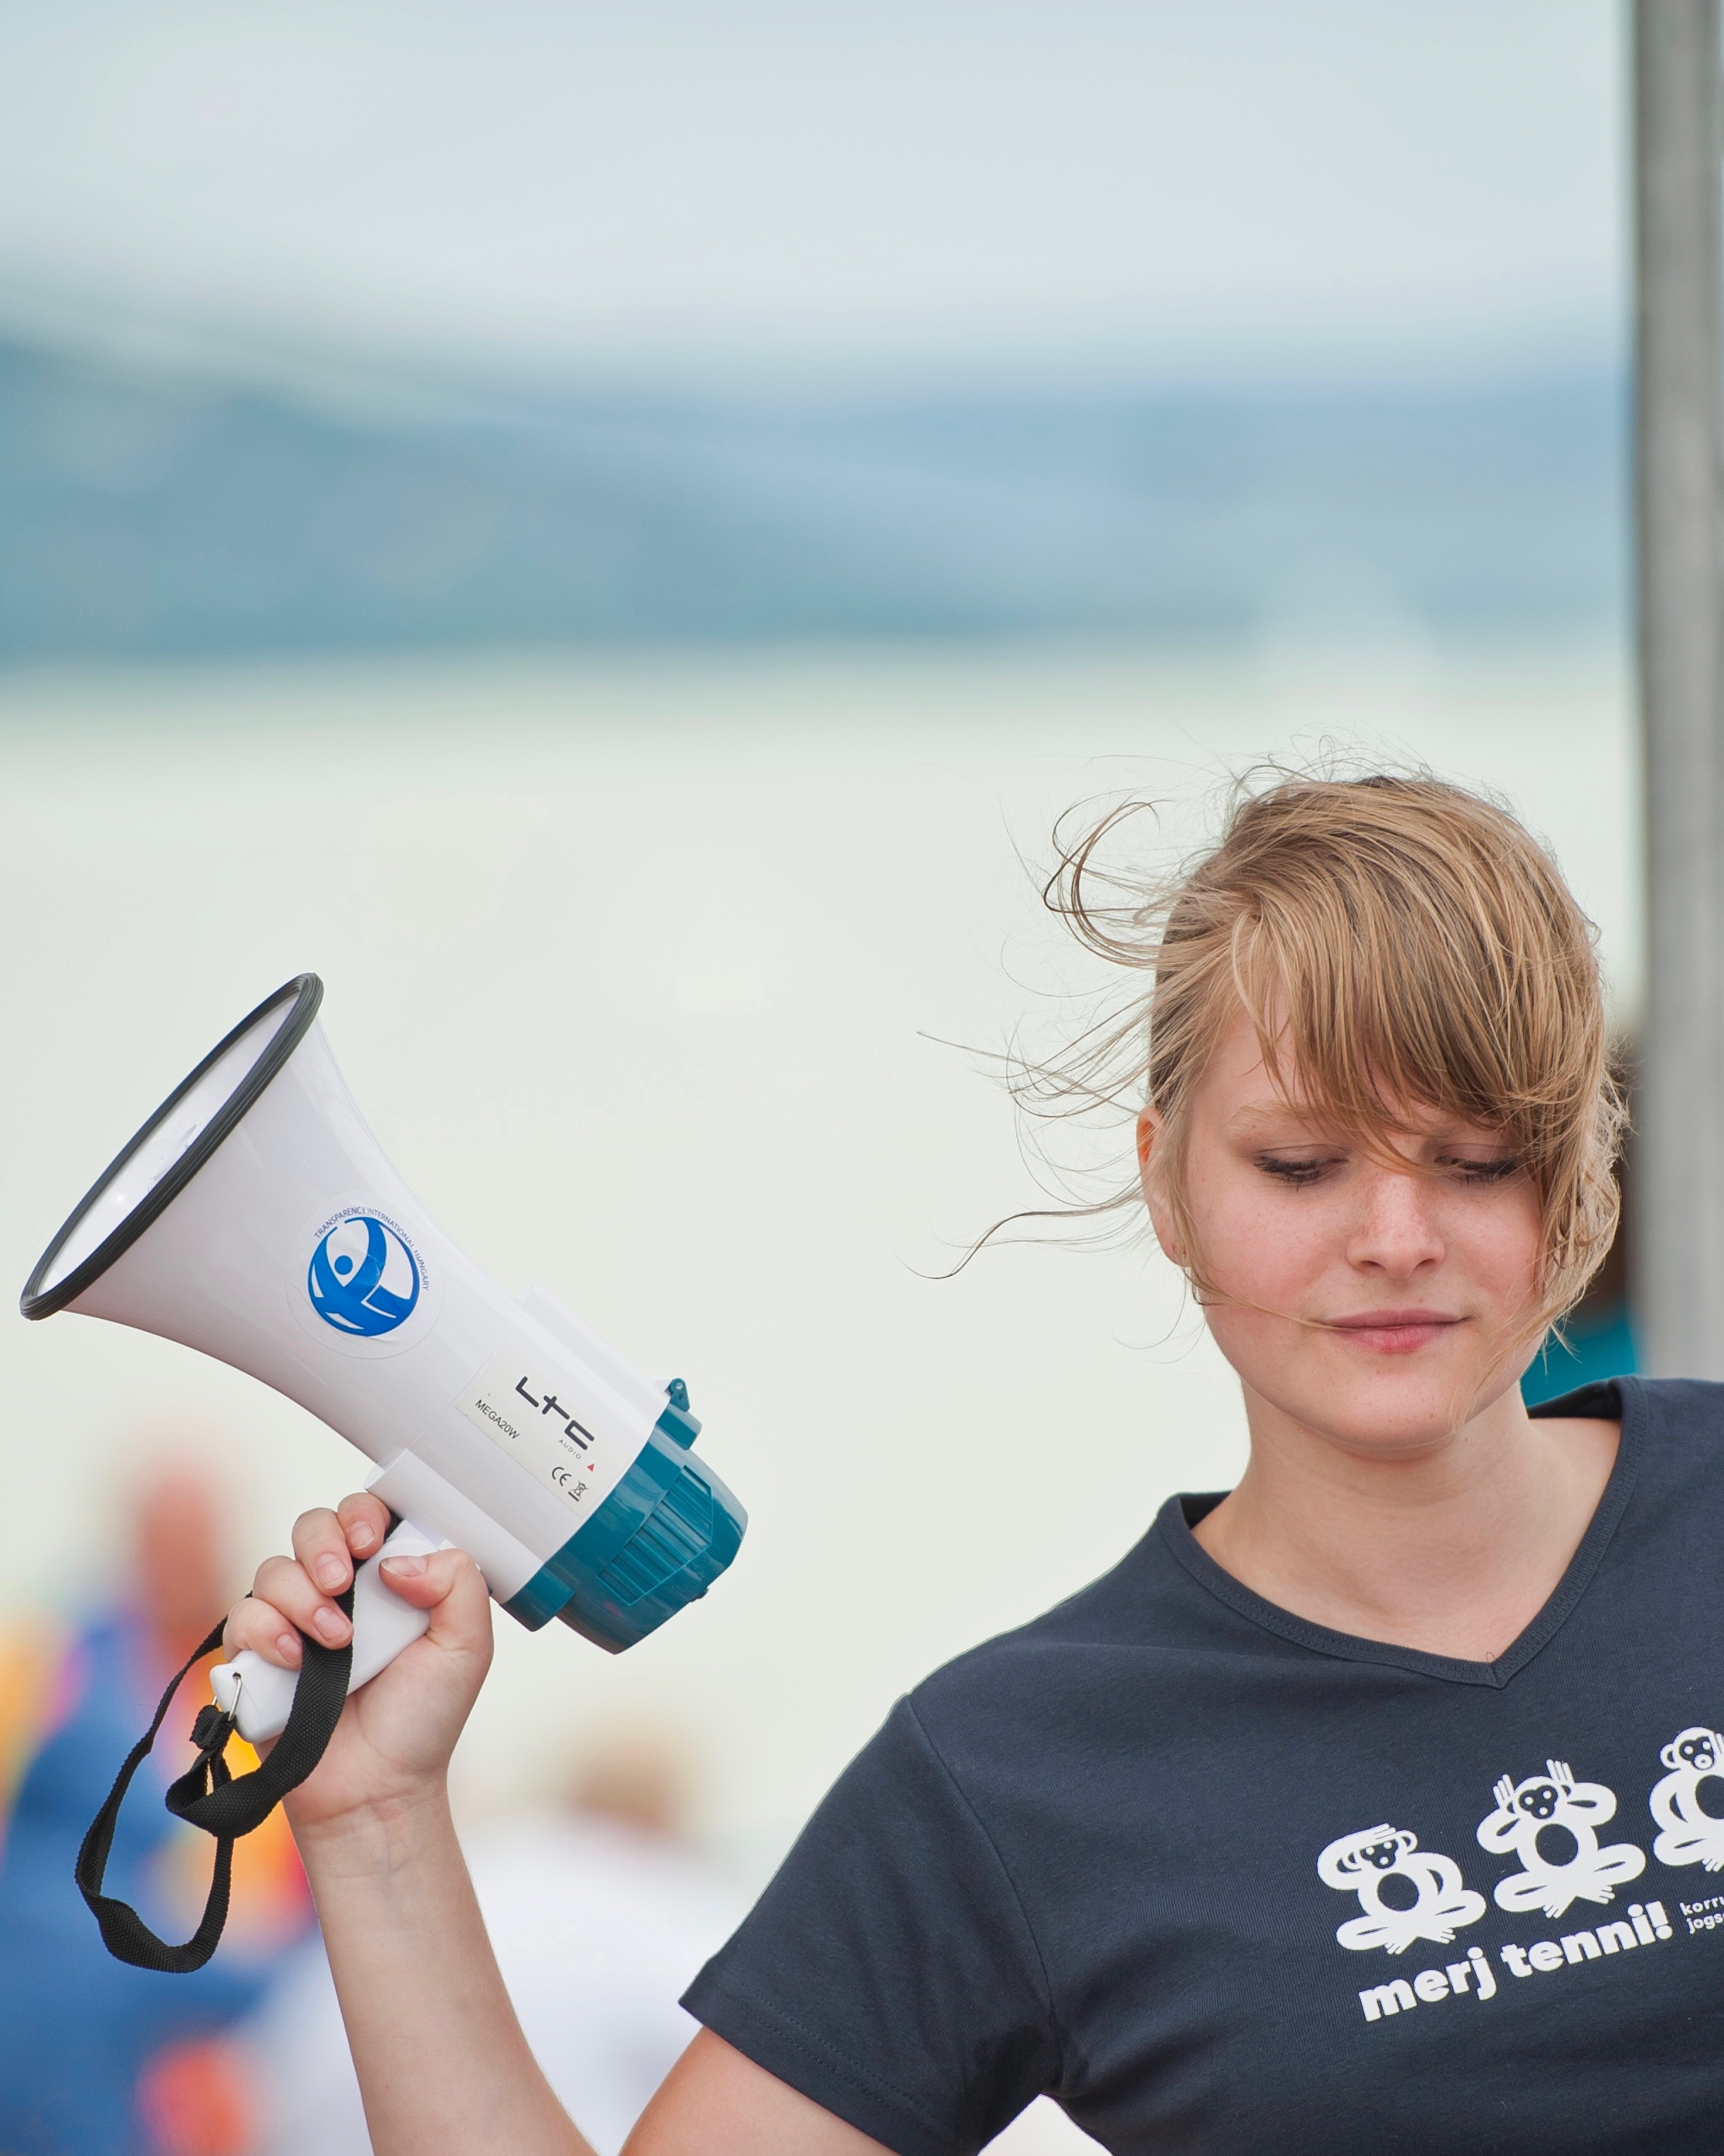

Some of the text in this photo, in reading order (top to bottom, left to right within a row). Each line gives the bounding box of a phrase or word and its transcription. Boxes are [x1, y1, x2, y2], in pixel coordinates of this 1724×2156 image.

[313, 1206, 429, 1291] TRANSPARENCY INTERNATIONAL HUNGARY
[474, 1398, 520, 1440] MEGA20W
[558, 1438, 582, 1460] AUDIO
[551, 1466, 572, 1487] CE
[1686, 1912, 1724, 1935] jogs
[1358, 1900, 1673, 2022] merj tenni!
